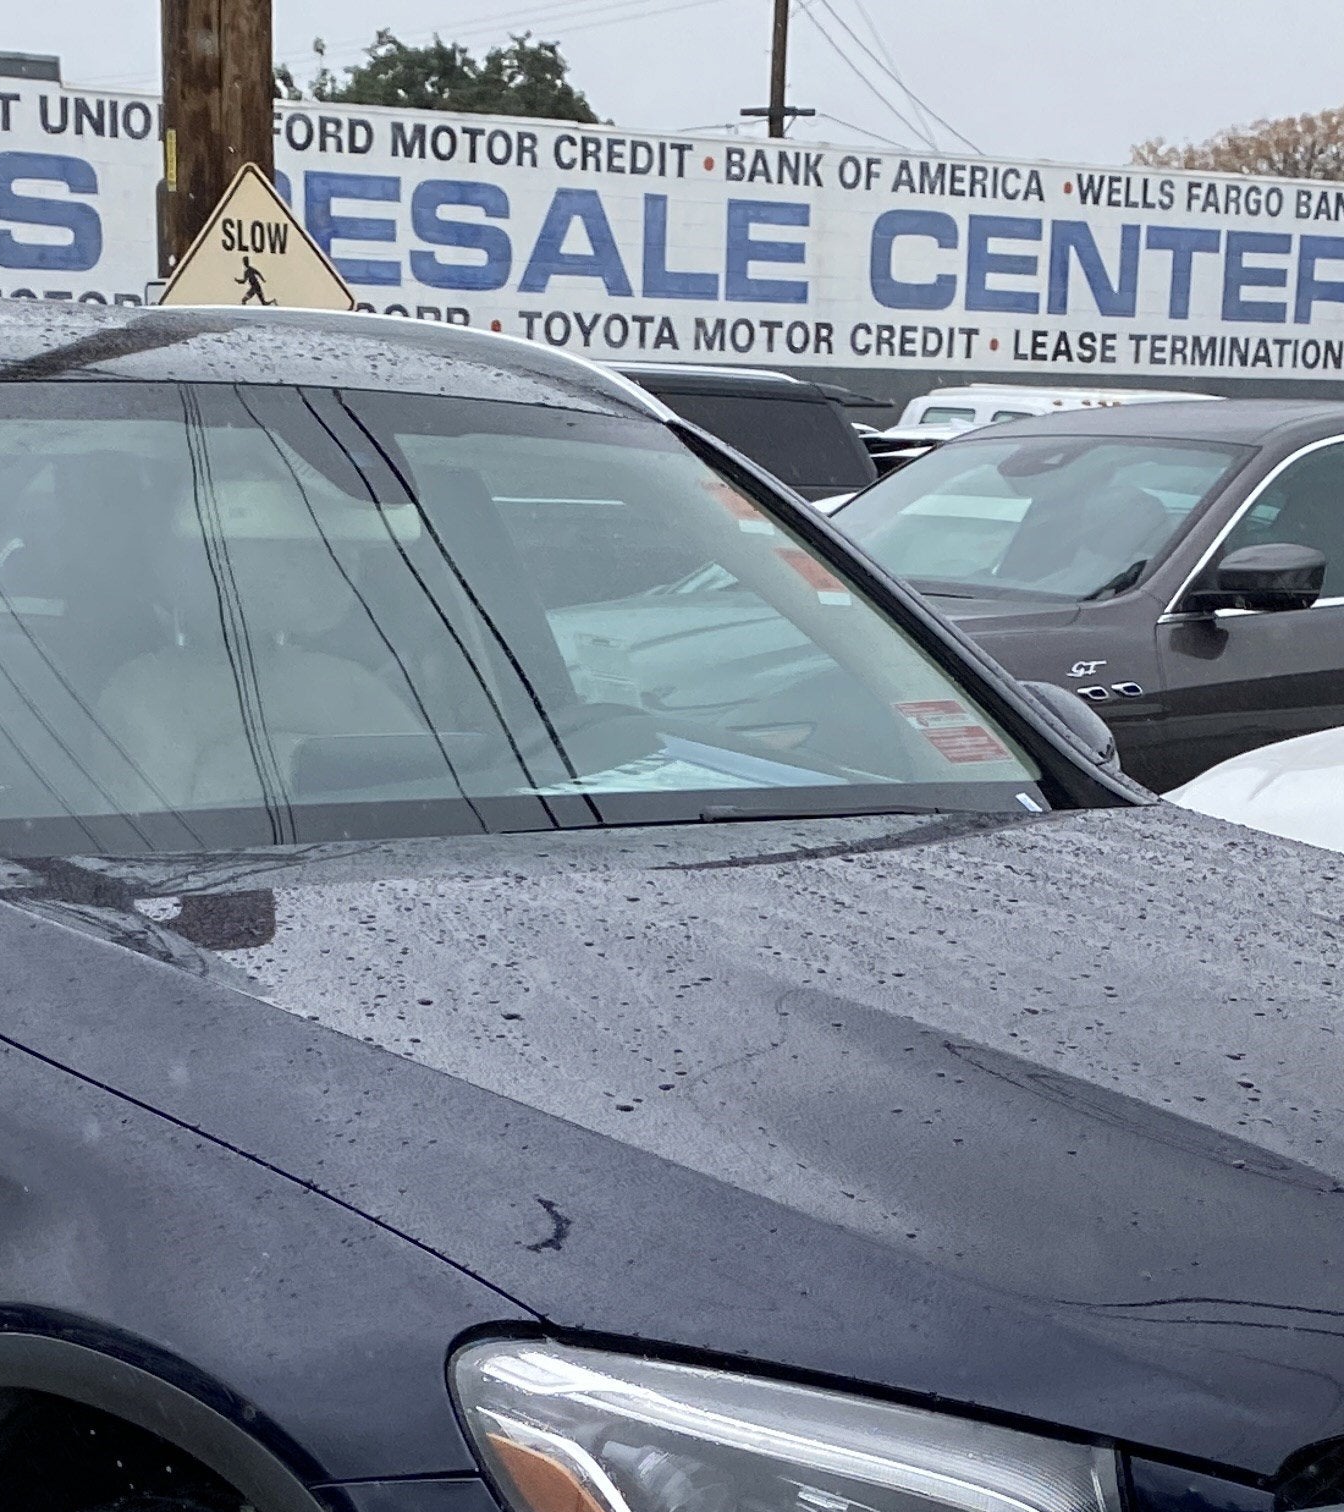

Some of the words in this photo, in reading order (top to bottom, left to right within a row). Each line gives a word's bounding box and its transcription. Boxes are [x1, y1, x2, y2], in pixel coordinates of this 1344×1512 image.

[40, 94, 164, 142] UNIO
[392, 121, 538, 168] MOTOR
[553, 134, 693, 178] CREDIT
[725, 147, 824, 188] BANK
[838, 155, 882, 191] OF
[892, 160, 1045, 202] AMERICA
[1076, 173, 1175, 210] WELLS
[1186, 181, 1283, 218] FARGO
[221, 217, 288, 255] SLOW
[274, 169, 811, 304] ESALE
[518, 310, 680, 351] TOYOTA
[694, 317, 834, 355] MOTOR
[850, 322, 980, 359] CREDIT
[1013, 329, 1117, 364] LEASE
